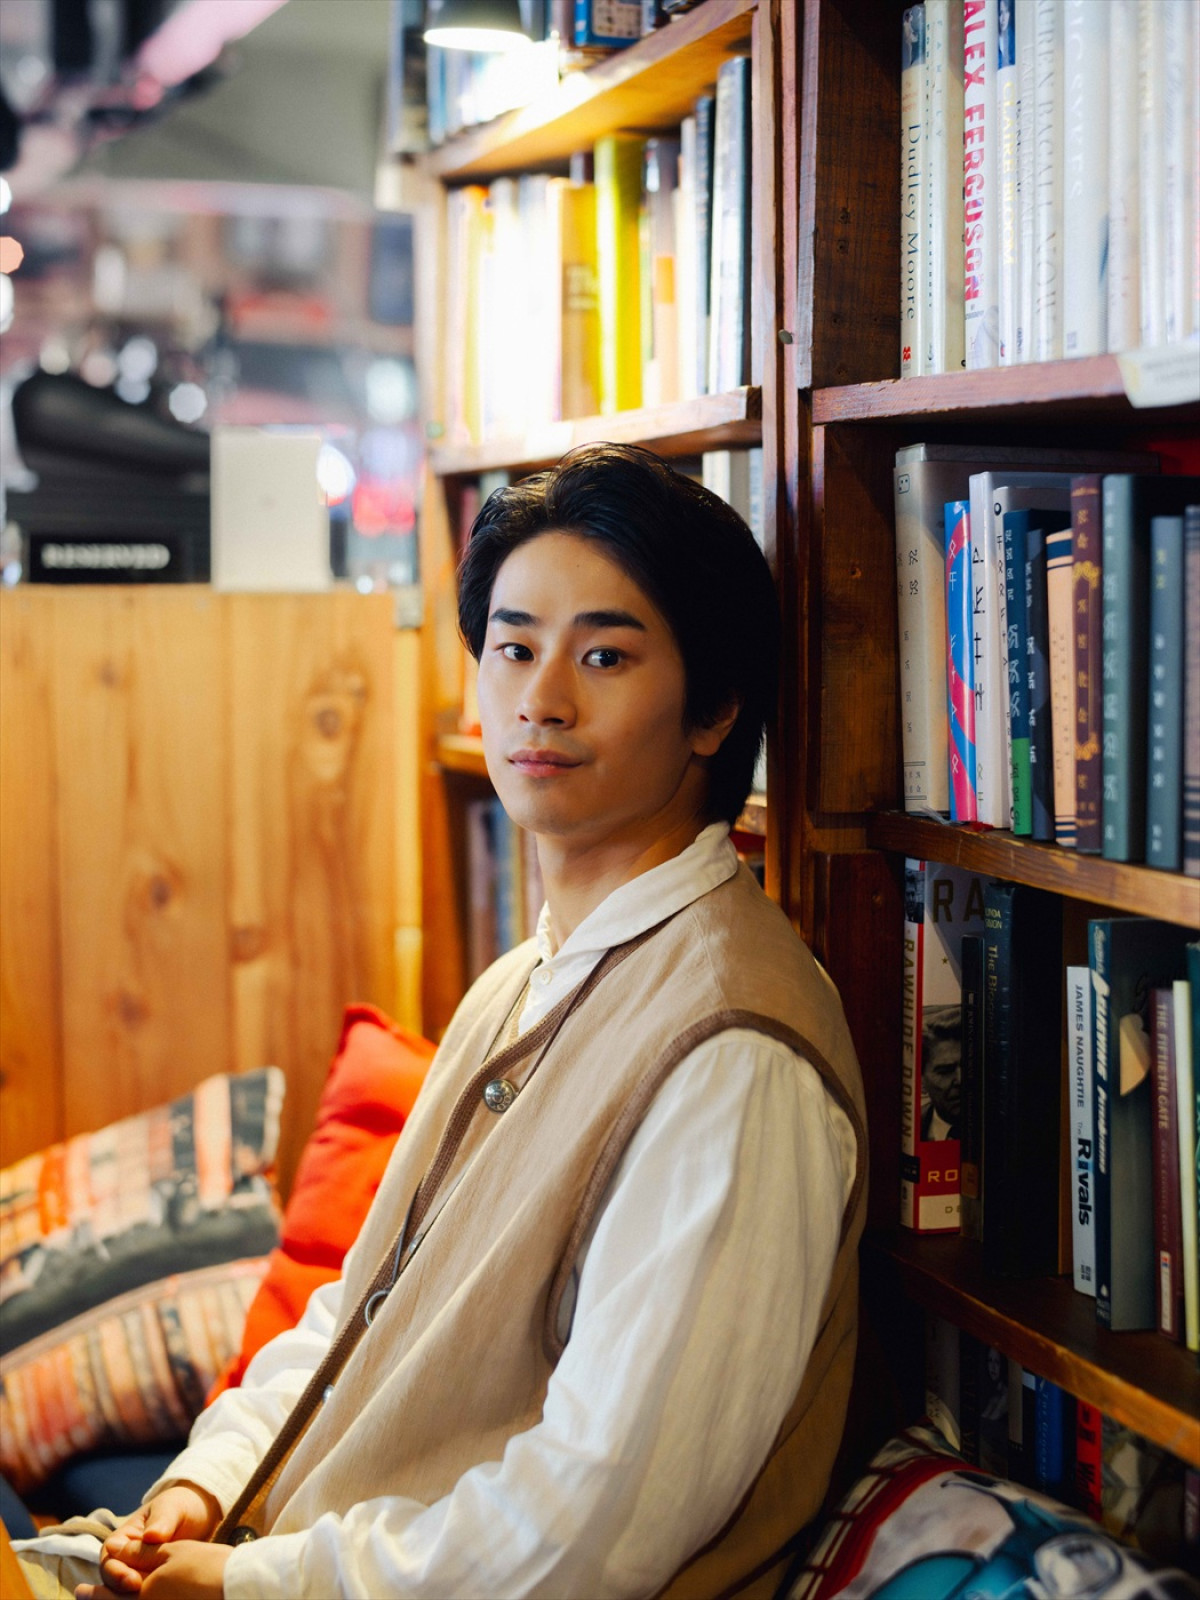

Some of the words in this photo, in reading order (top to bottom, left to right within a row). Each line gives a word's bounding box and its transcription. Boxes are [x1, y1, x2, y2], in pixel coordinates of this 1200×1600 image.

[963, 0, 986, 93] ALEX
[904, 123, 921, 221] Dudley
[1002, 81, 1014, 174] CLAIRE
[1037, 99, 1054, 217] BACALL
[1068, 73, 1084, 200] SYKES
[963, 103, 985, 302] FERGUSON
[1003, 181, 1015, 265] BLOOM
[906, 232, 919, 321] Moore
[903, 938, 915, 1054] RAWHIDE
[1075, 984, 1085, 1033] JAMES
[1156, 1002, 1168, 1029] THE
[902, 1064, 913, 1138] DOWN
[1075, 1036, 1086, 1108] NAUGHTIE
[1156, 1033, 1169, 1092] FIFTIETH
[1157, 1095, 1169, 1130] GATE
[927, 1168, 959, 1183] RO
[1077, 1137, 1092, 1226] Rivals
